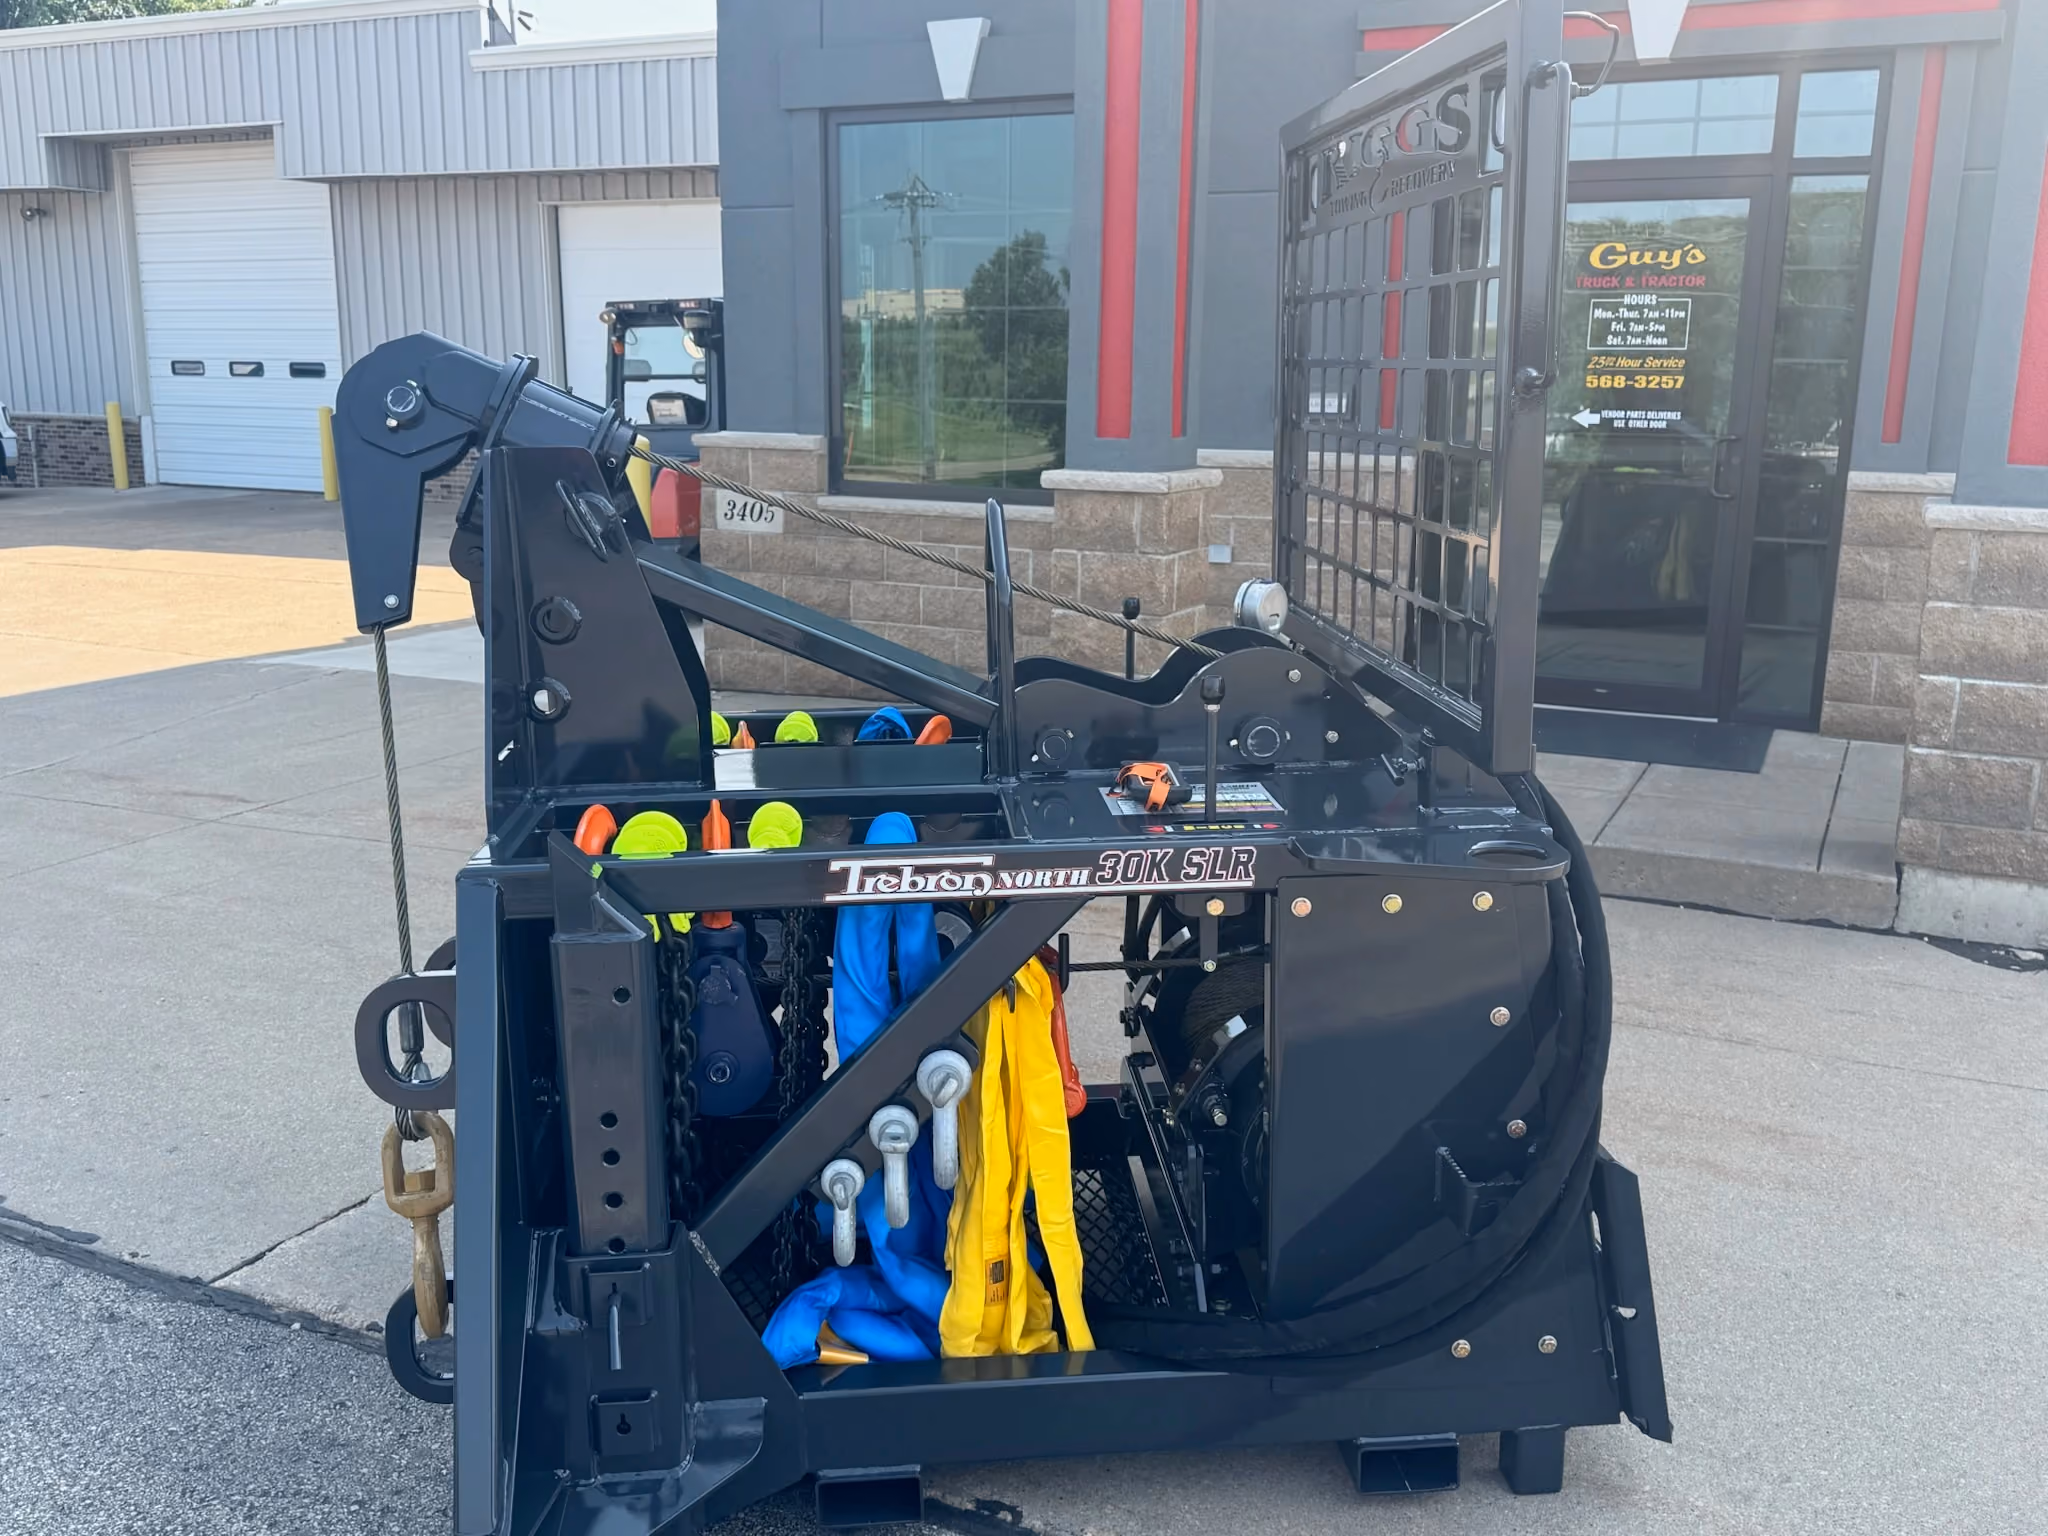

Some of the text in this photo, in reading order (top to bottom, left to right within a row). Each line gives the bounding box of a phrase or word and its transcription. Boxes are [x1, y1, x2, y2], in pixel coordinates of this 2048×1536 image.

[1391, 159, 1457, 198] RECOVERY
[1589, 242, 1707, 270] Guy's
[1576, 275, 1620, 289] TRUCK
[1641, 274, 1706, 288] TRACTOR
[1623, 293, 1658, 305] HOURS
[1611, 321, 1626, 332] Fri.
[1606, 334, 1624, 346] Sat.
[1615, 356, 1642, 368] Hour
[1643, 356, 1686, 368] Service
[1585, 374, 1685, 388] 568-3257
[1601, 409, 1681, 420] VENDOR PARTS DELIVERIES
[1613, 420, 1667, 429] USE OTHER DOOR
[723, 499, 775, 524] 3405
[828, 846, 1258, 897] Trebron NORTH 30K SLR
